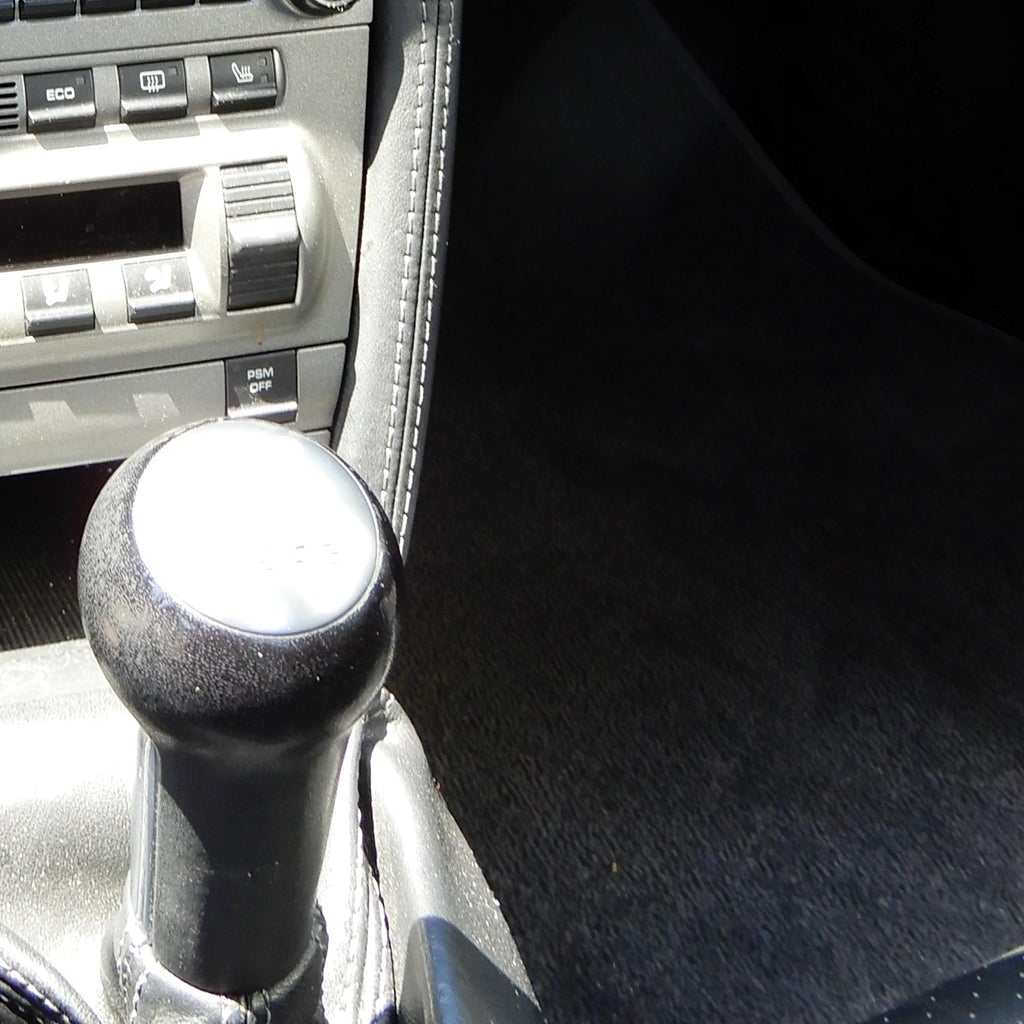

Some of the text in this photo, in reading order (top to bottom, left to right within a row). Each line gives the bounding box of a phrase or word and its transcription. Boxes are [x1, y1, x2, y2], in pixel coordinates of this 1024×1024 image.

[46, 86, 76, 102] ECO
[247, 366, 274, 381] PSM
[249, 380, 273, 394] OFF
